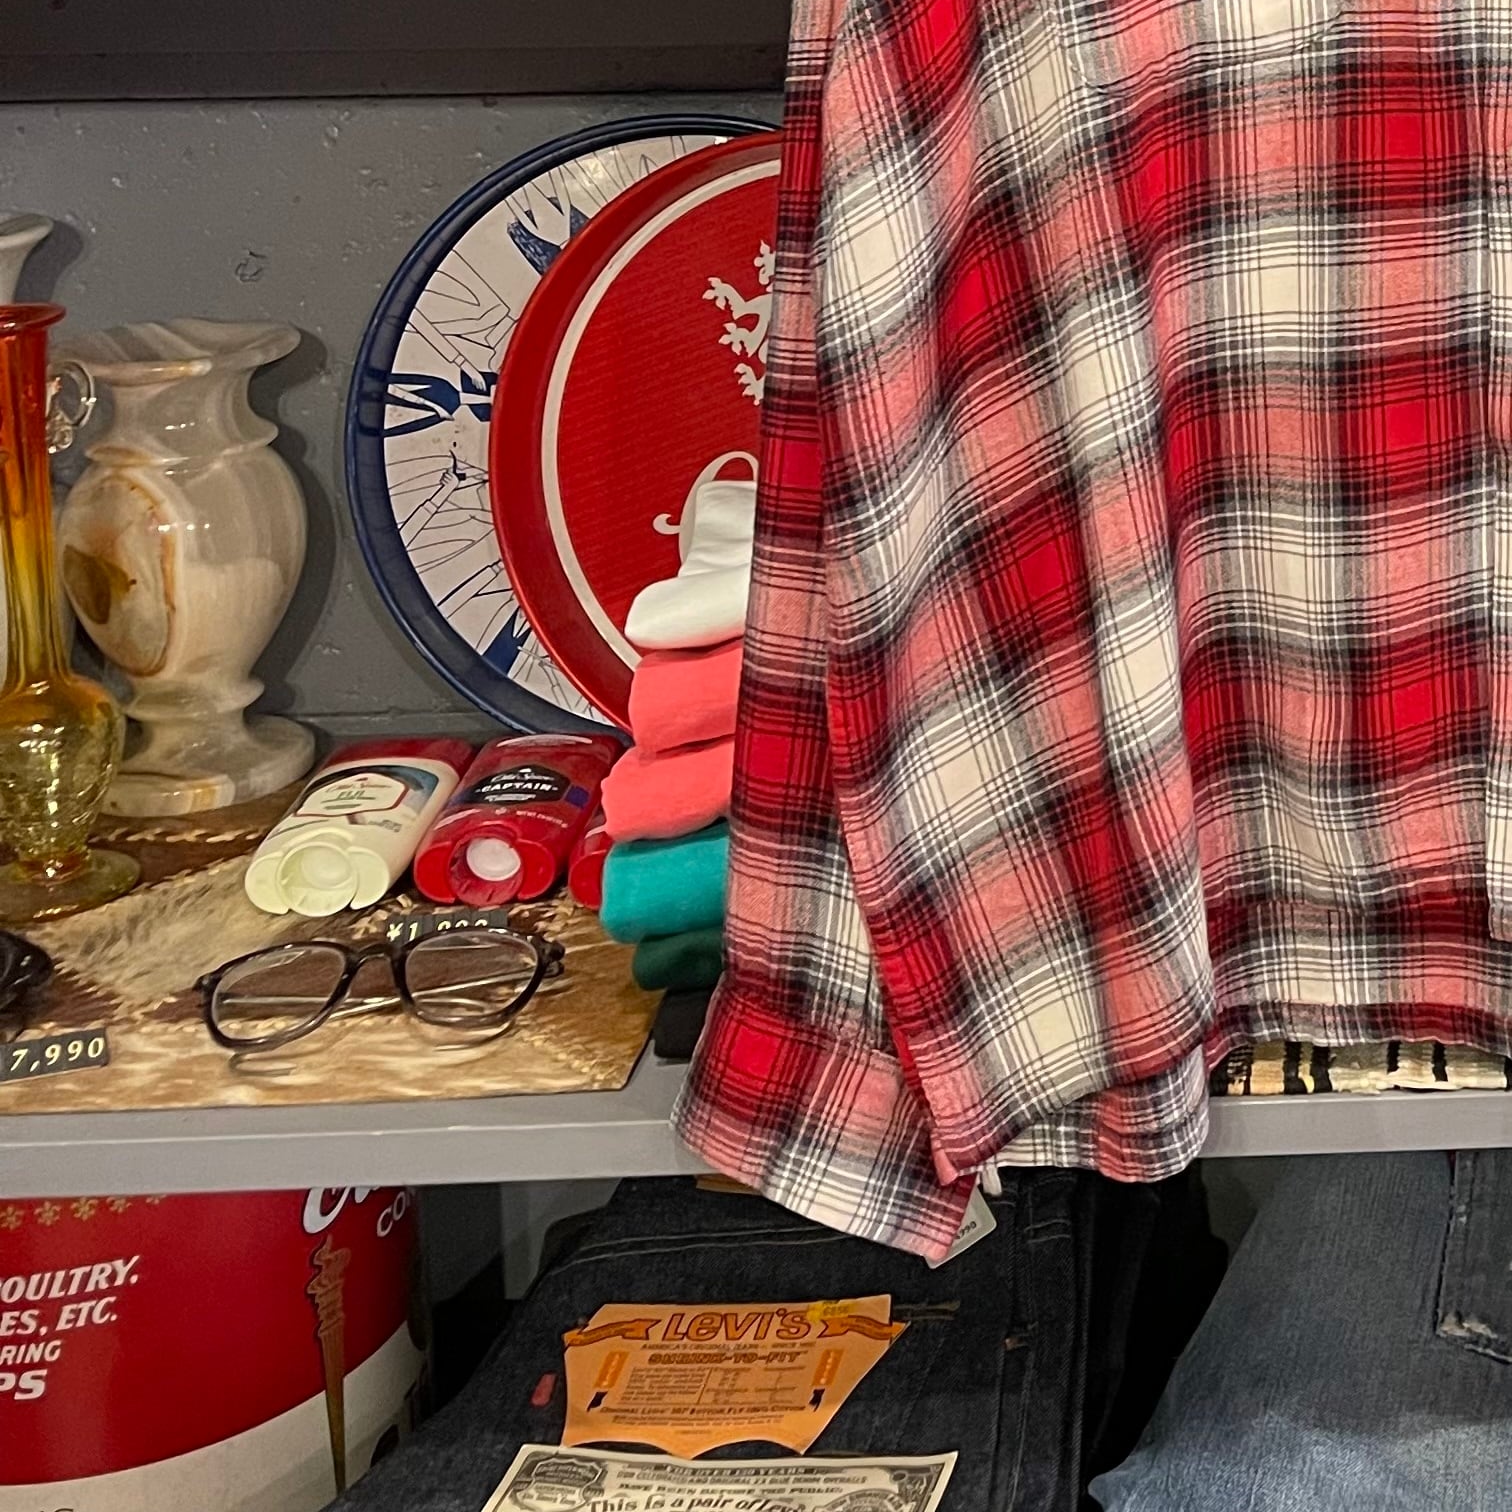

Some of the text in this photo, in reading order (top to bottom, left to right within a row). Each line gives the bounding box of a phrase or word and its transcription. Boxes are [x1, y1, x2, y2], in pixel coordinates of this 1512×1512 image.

[482, 783, 552, 792] CAPTAIN
[11, 1038, 104, 1072] 7,990
[0, 1256, 140, 1303] OULTRY.
[55, 1297, 117, 1331] ETC.
[590, 1498, 638, 1512] This
[670, 1497, 684, 1508] a
[687, 1495, 733, 1512] pair
